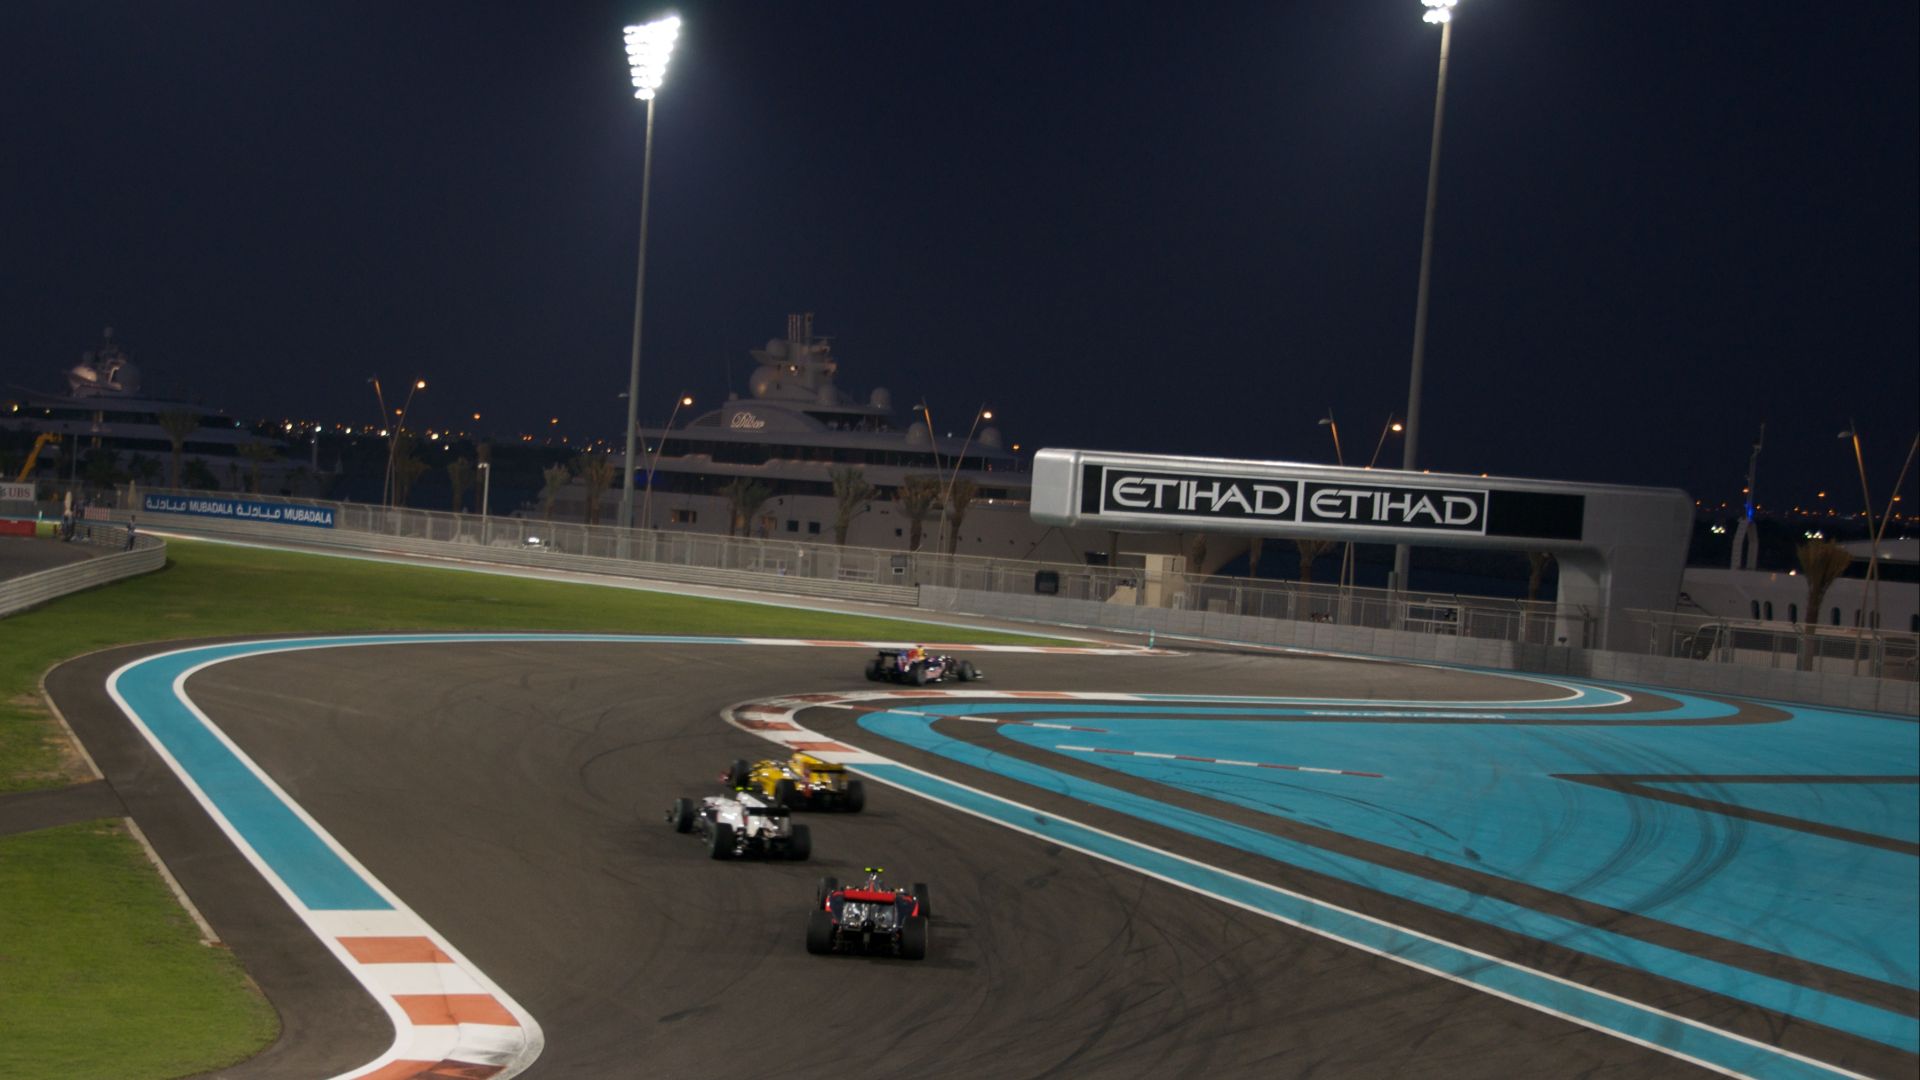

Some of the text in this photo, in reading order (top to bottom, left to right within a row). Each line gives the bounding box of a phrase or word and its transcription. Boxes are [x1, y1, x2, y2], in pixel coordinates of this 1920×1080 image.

[9, 487, 31, 498] UBS
[1112, 476, 1291, 516] ETIHAD
[189, 500, 233, 515] MUBADALA
[284, 507, 332, 525] MUBADALA
[1310, 488, 1478, 526] ETIHAD
